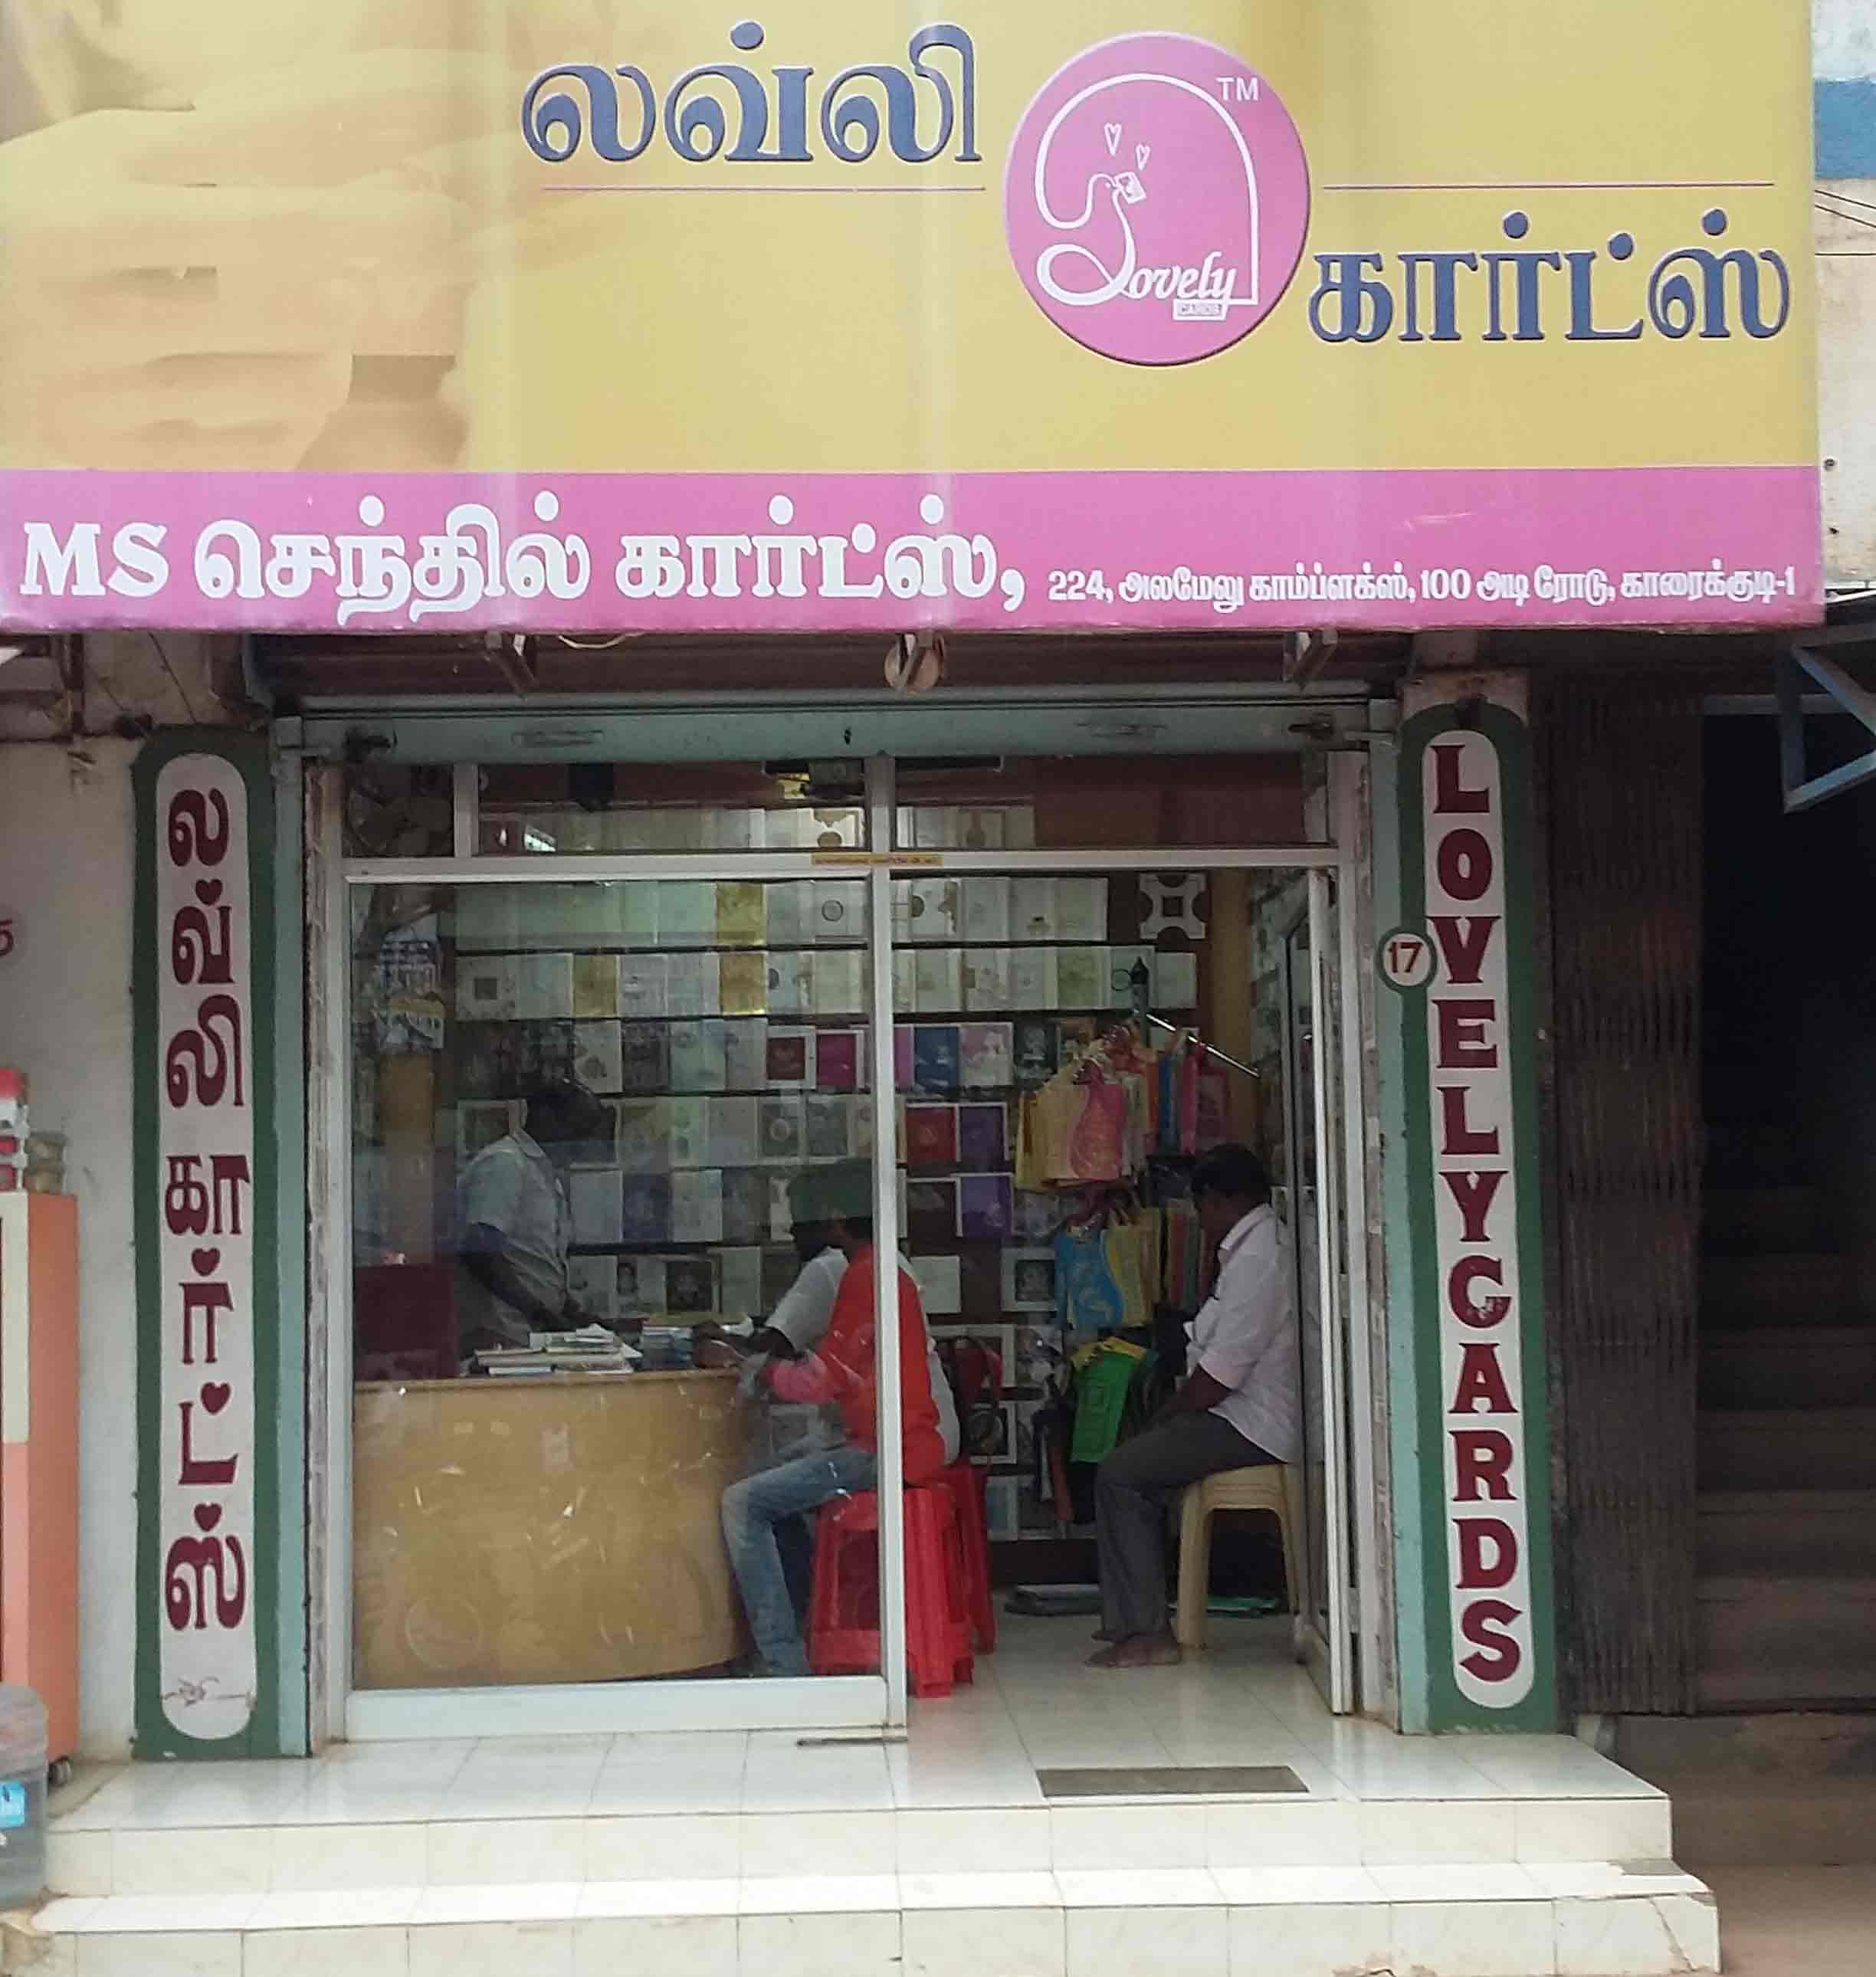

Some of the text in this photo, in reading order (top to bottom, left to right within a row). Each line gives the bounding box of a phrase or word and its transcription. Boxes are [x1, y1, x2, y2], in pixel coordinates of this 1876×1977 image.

[521, 20, 982, 162] லவ்லி
[1215, 76, 1260, 102] TM
[1308, 208, 1792, 343] கார்ட்ஸ்
[20, 490, 1025, 625] MS செந்தில் கார்ட்ஸ்,
[1048, 569, 1114, 603] 224,
[1421, 569, 1471, 600] 100
[1476, 570, 1530, 607] அடி
[1533, 564, 1616, 606] ரோடு,
[165, 786, 244, 1108] லவ்லி
[1388, 942, 1424, 974] 17
